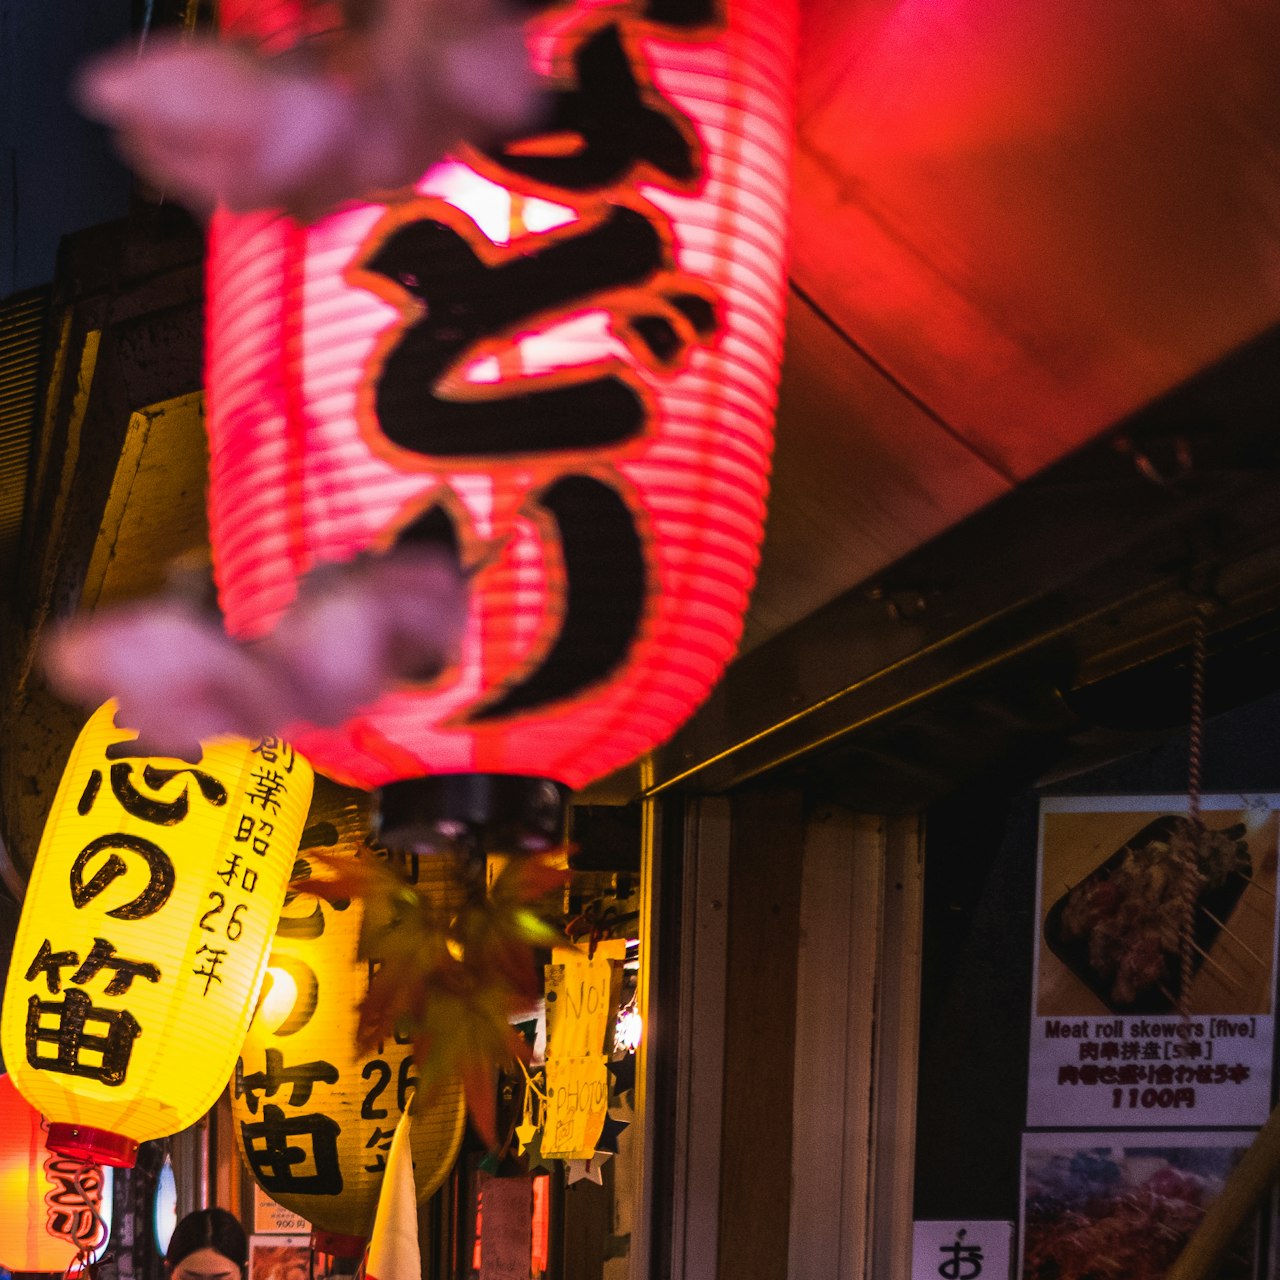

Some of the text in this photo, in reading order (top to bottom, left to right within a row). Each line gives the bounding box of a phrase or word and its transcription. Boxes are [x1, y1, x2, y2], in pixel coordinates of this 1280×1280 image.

[1045, 1018, 1256, 1039] Meat roll skewers [five]
[1110, 1087, 1195, 1109] 1100円
